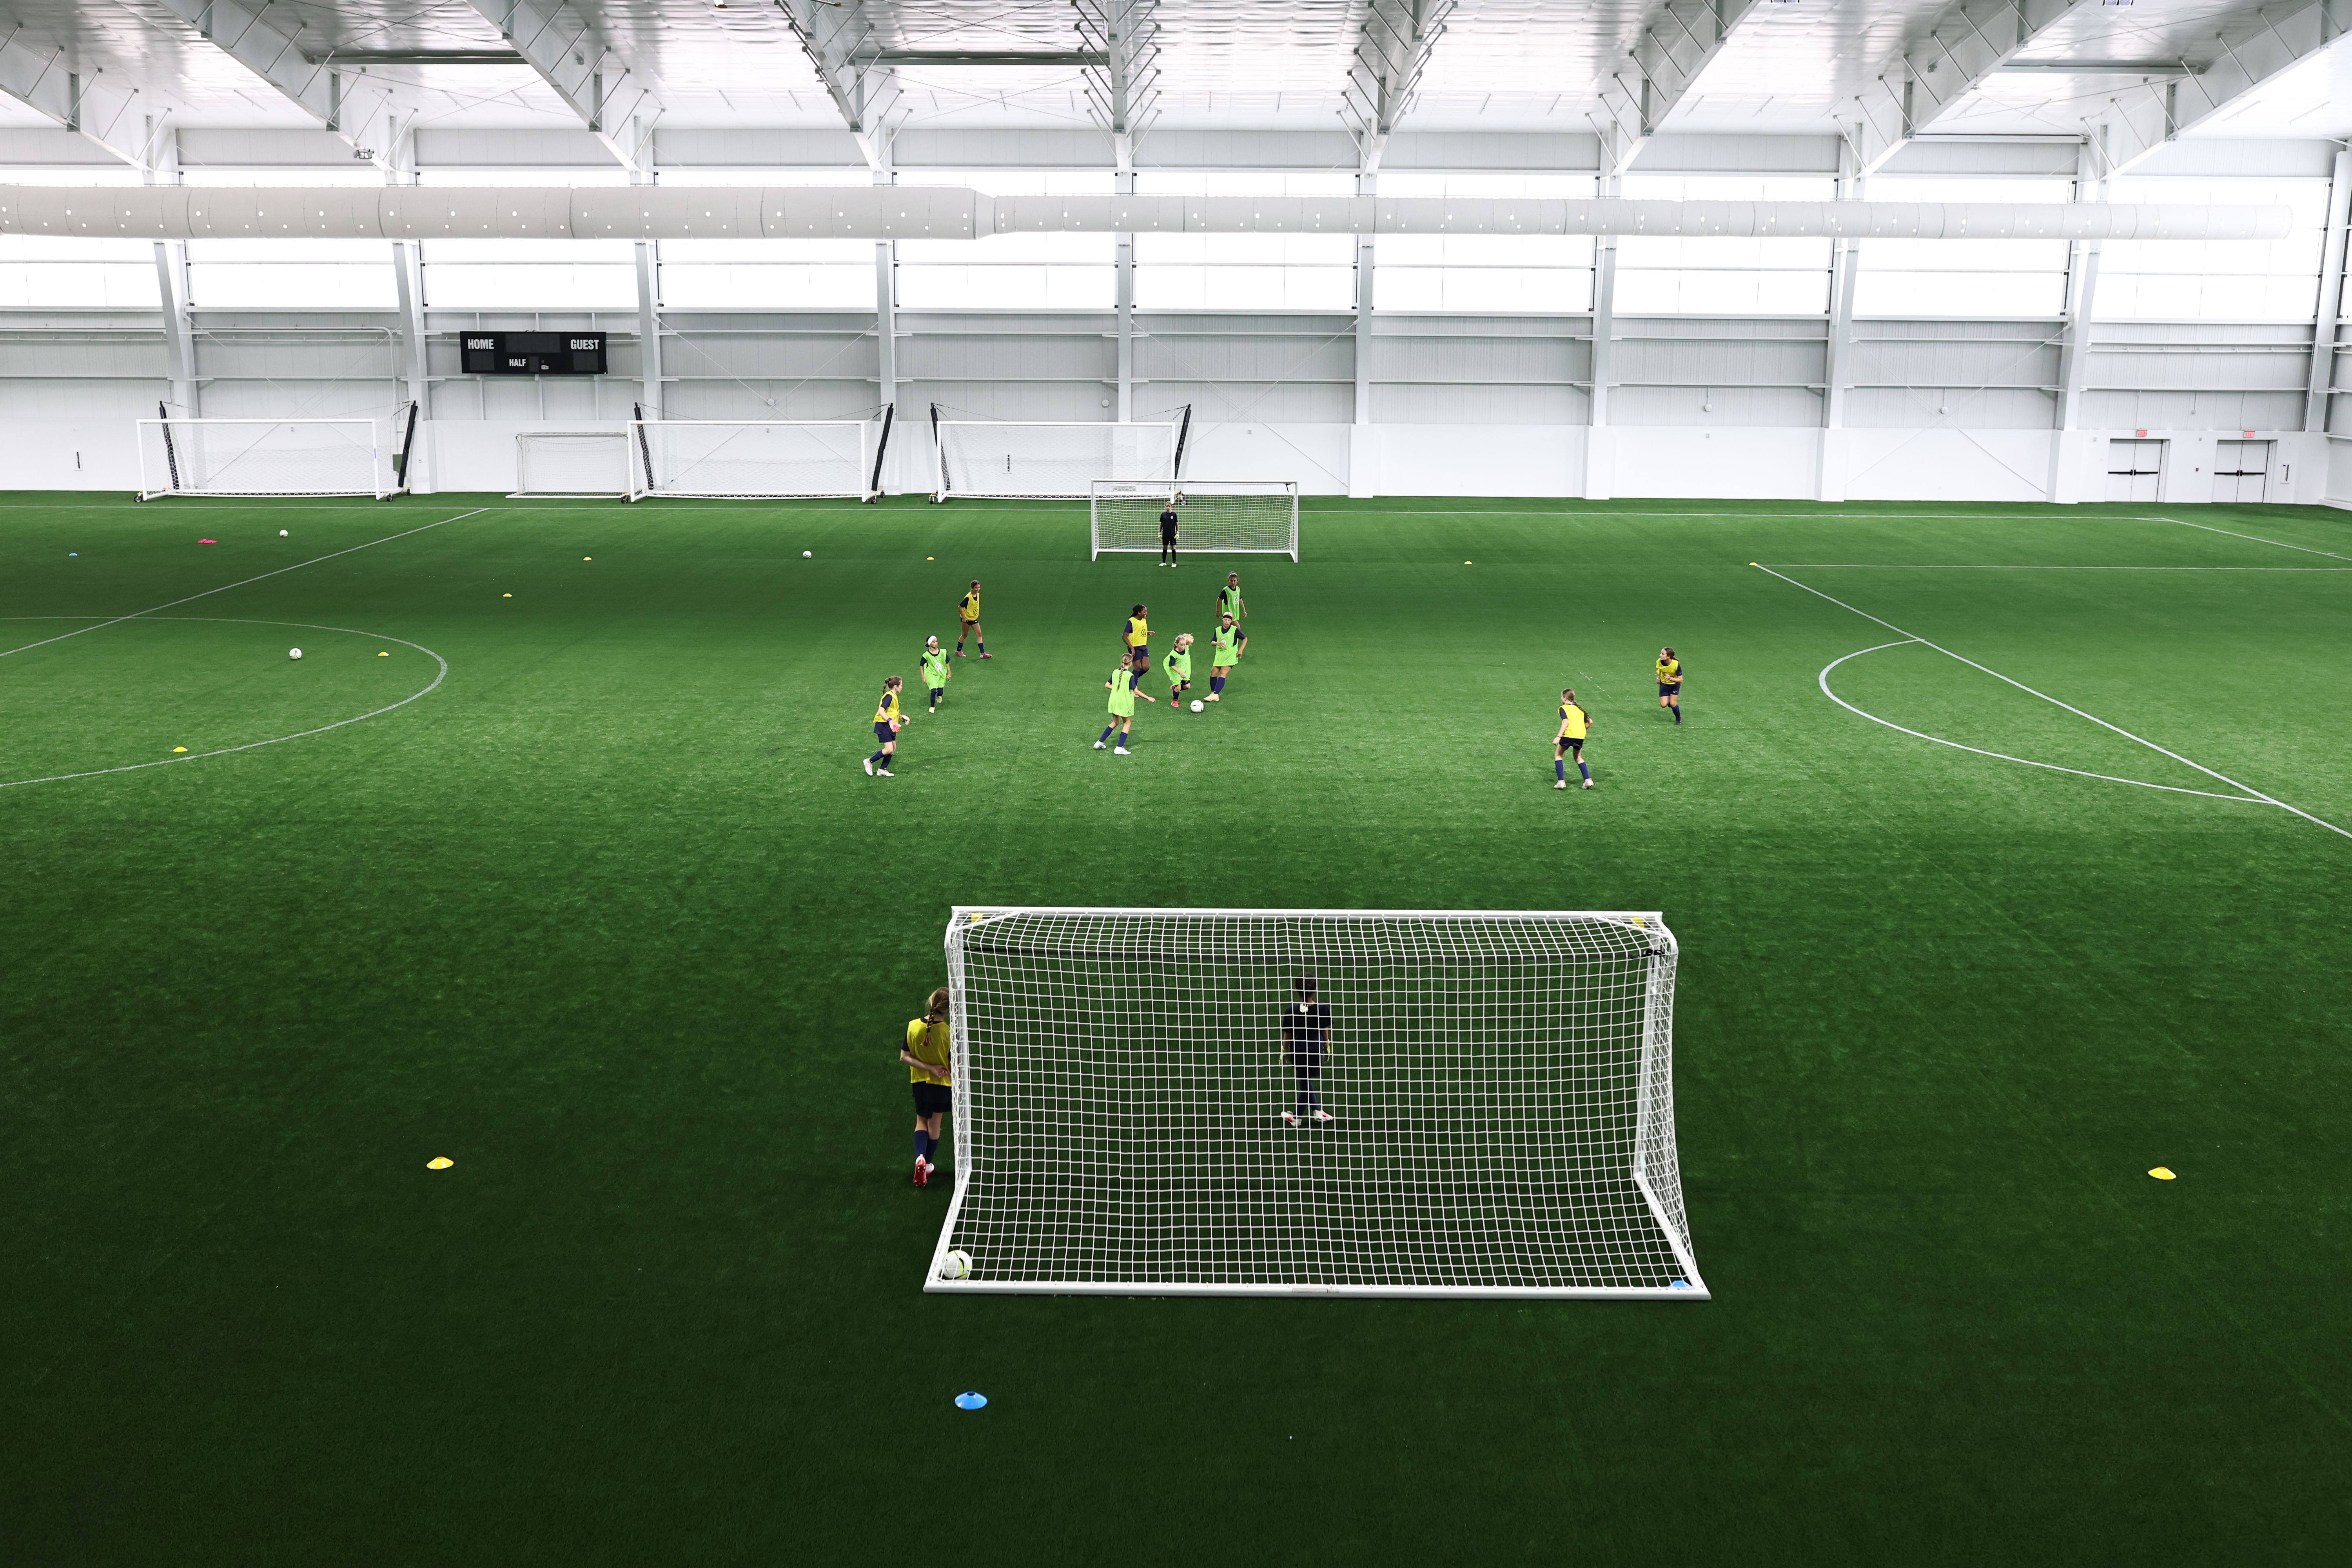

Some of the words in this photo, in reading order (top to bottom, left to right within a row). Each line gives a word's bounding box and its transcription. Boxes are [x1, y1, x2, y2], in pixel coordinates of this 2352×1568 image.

[468, 339, 494, 349] HOME
[570, 339, 599, 350] GUEST
[509, 358, 526, 367] HALF
[1141, 628, 1147, 637] VW
